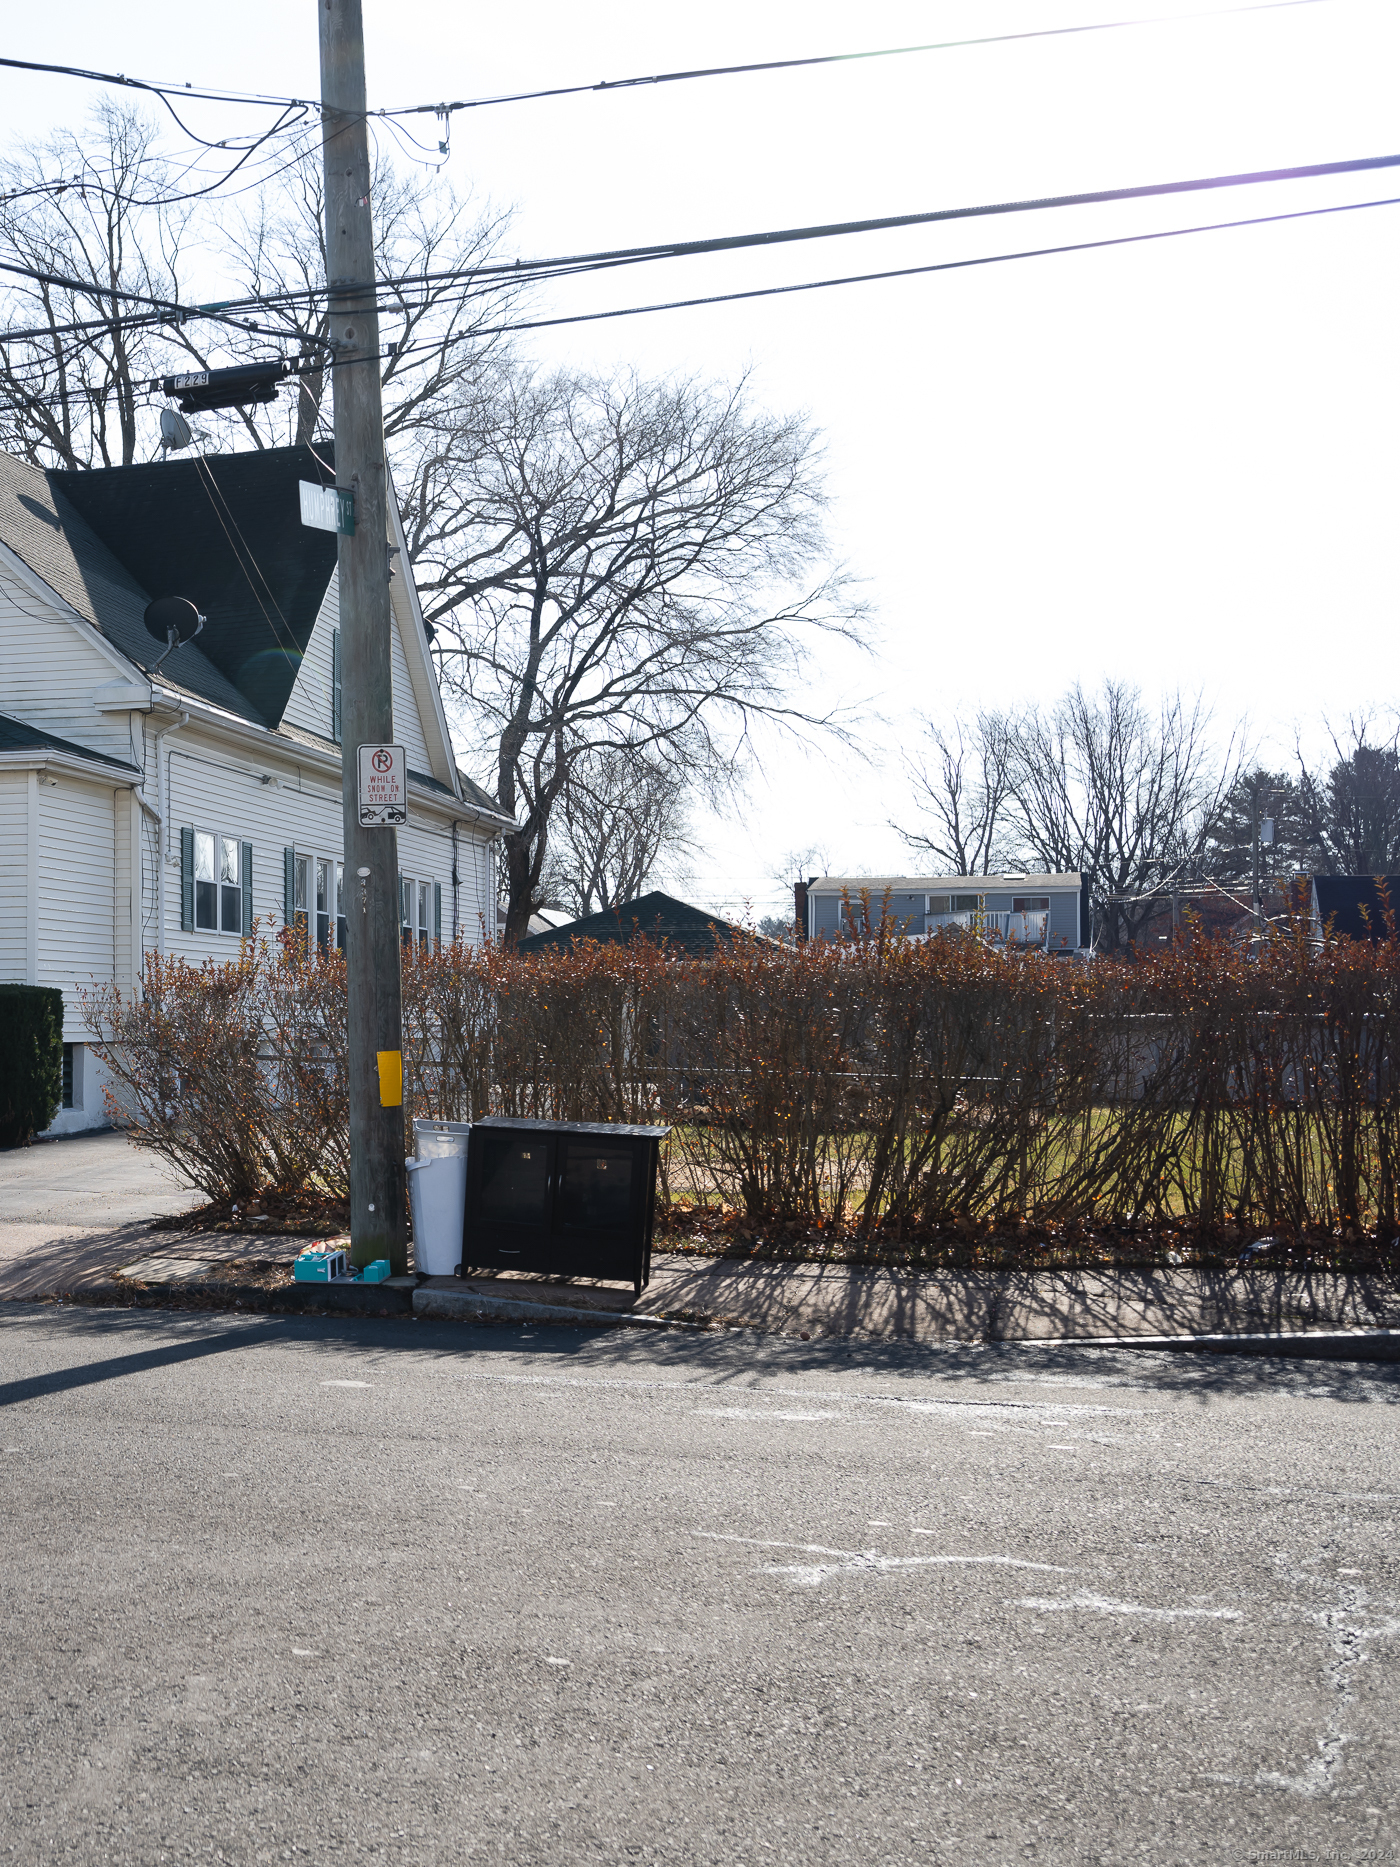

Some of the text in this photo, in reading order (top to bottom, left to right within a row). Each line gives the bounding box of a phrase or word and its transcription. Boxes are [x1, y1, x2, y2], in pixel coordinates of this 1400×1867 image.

[302, 489, 352, 528] HUMPHREY ST
[369, 775, 396, 783] WHILE
[367, 785, 399, 793] SNOW ON
[369, 794, 397, 802] STREET
